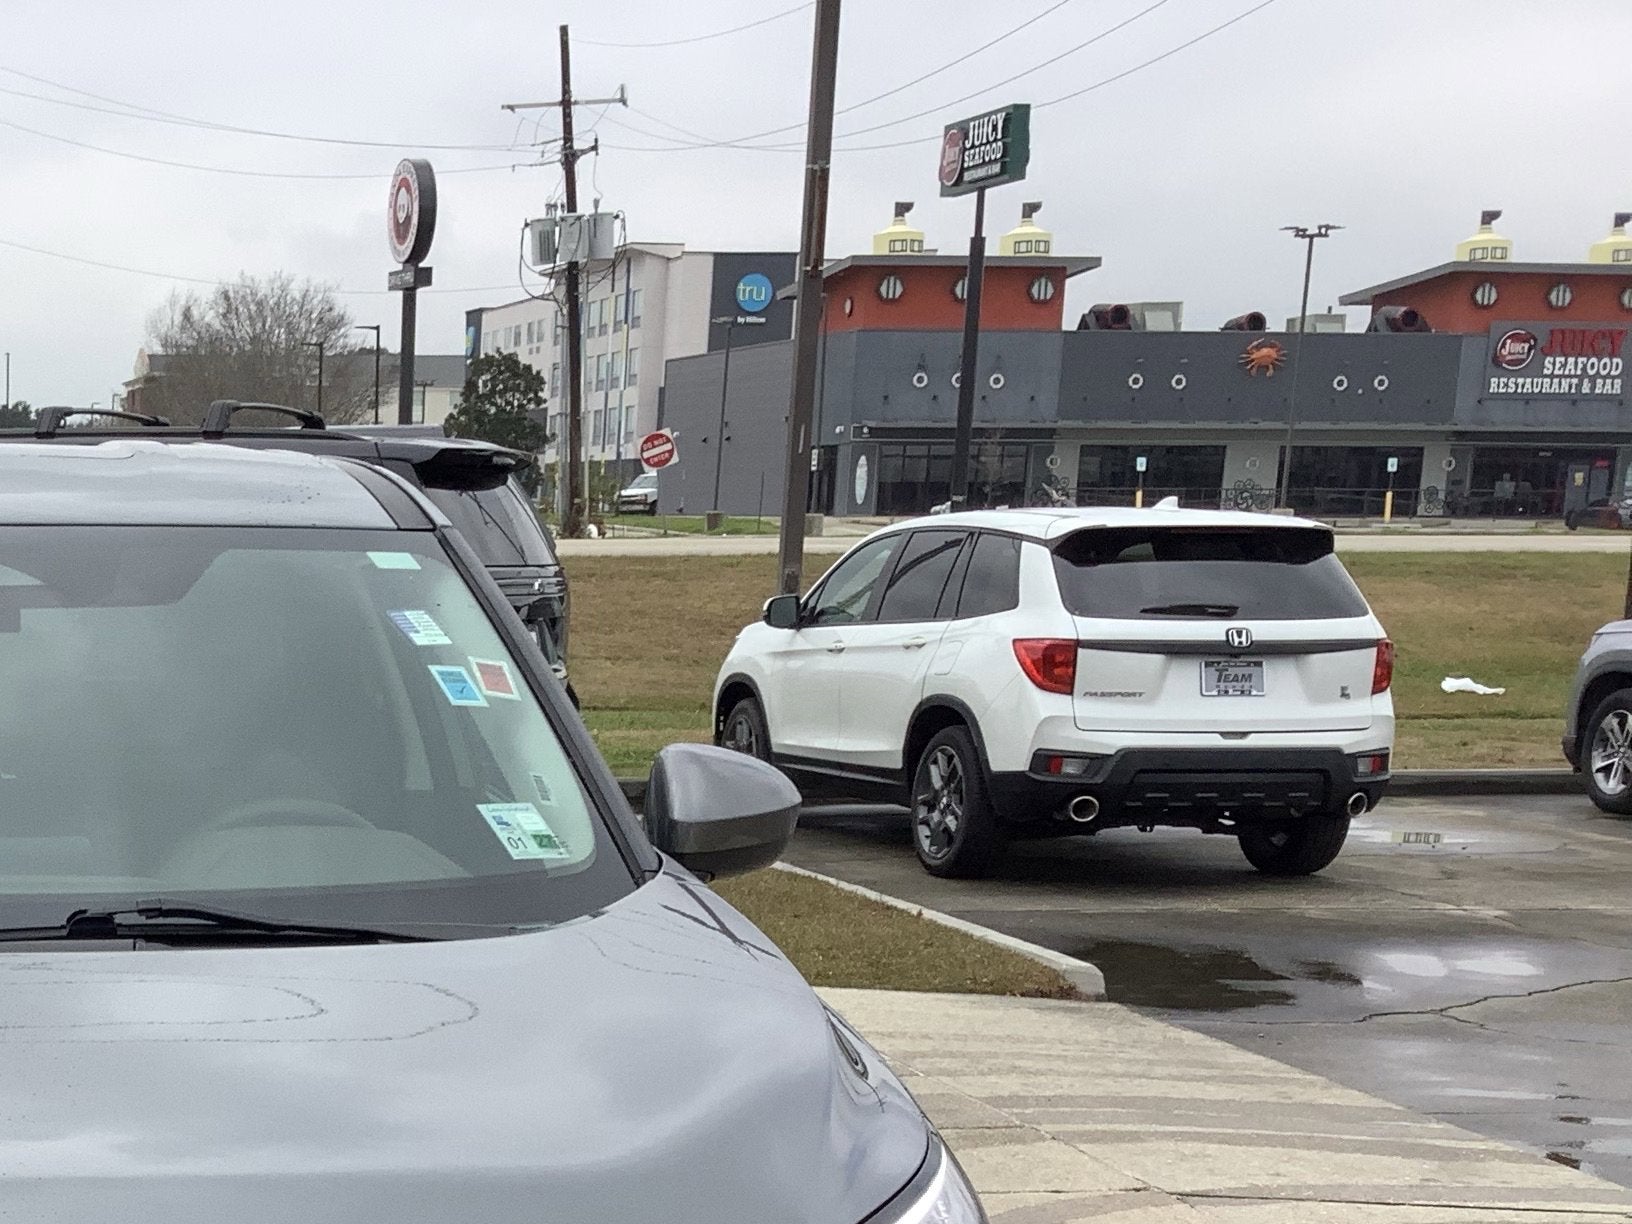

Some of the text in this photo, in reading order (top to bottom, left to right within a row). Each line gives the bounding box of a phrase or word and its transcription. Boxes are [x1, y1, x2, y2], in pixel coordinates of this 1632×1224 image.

[965, 112, 1006, 148] JUICY
[964, 141, 1003, 168] SEAFOOD
[737, 282, 766, 301] tru
[1540, 329, 1626, 357] JUICY
[1543, 356, 1623, 376] SEAFOOD
[1489, 377, 1622, 394] RESTAURANT & BAR
[1215, 667, 1253, 683] TEAM
